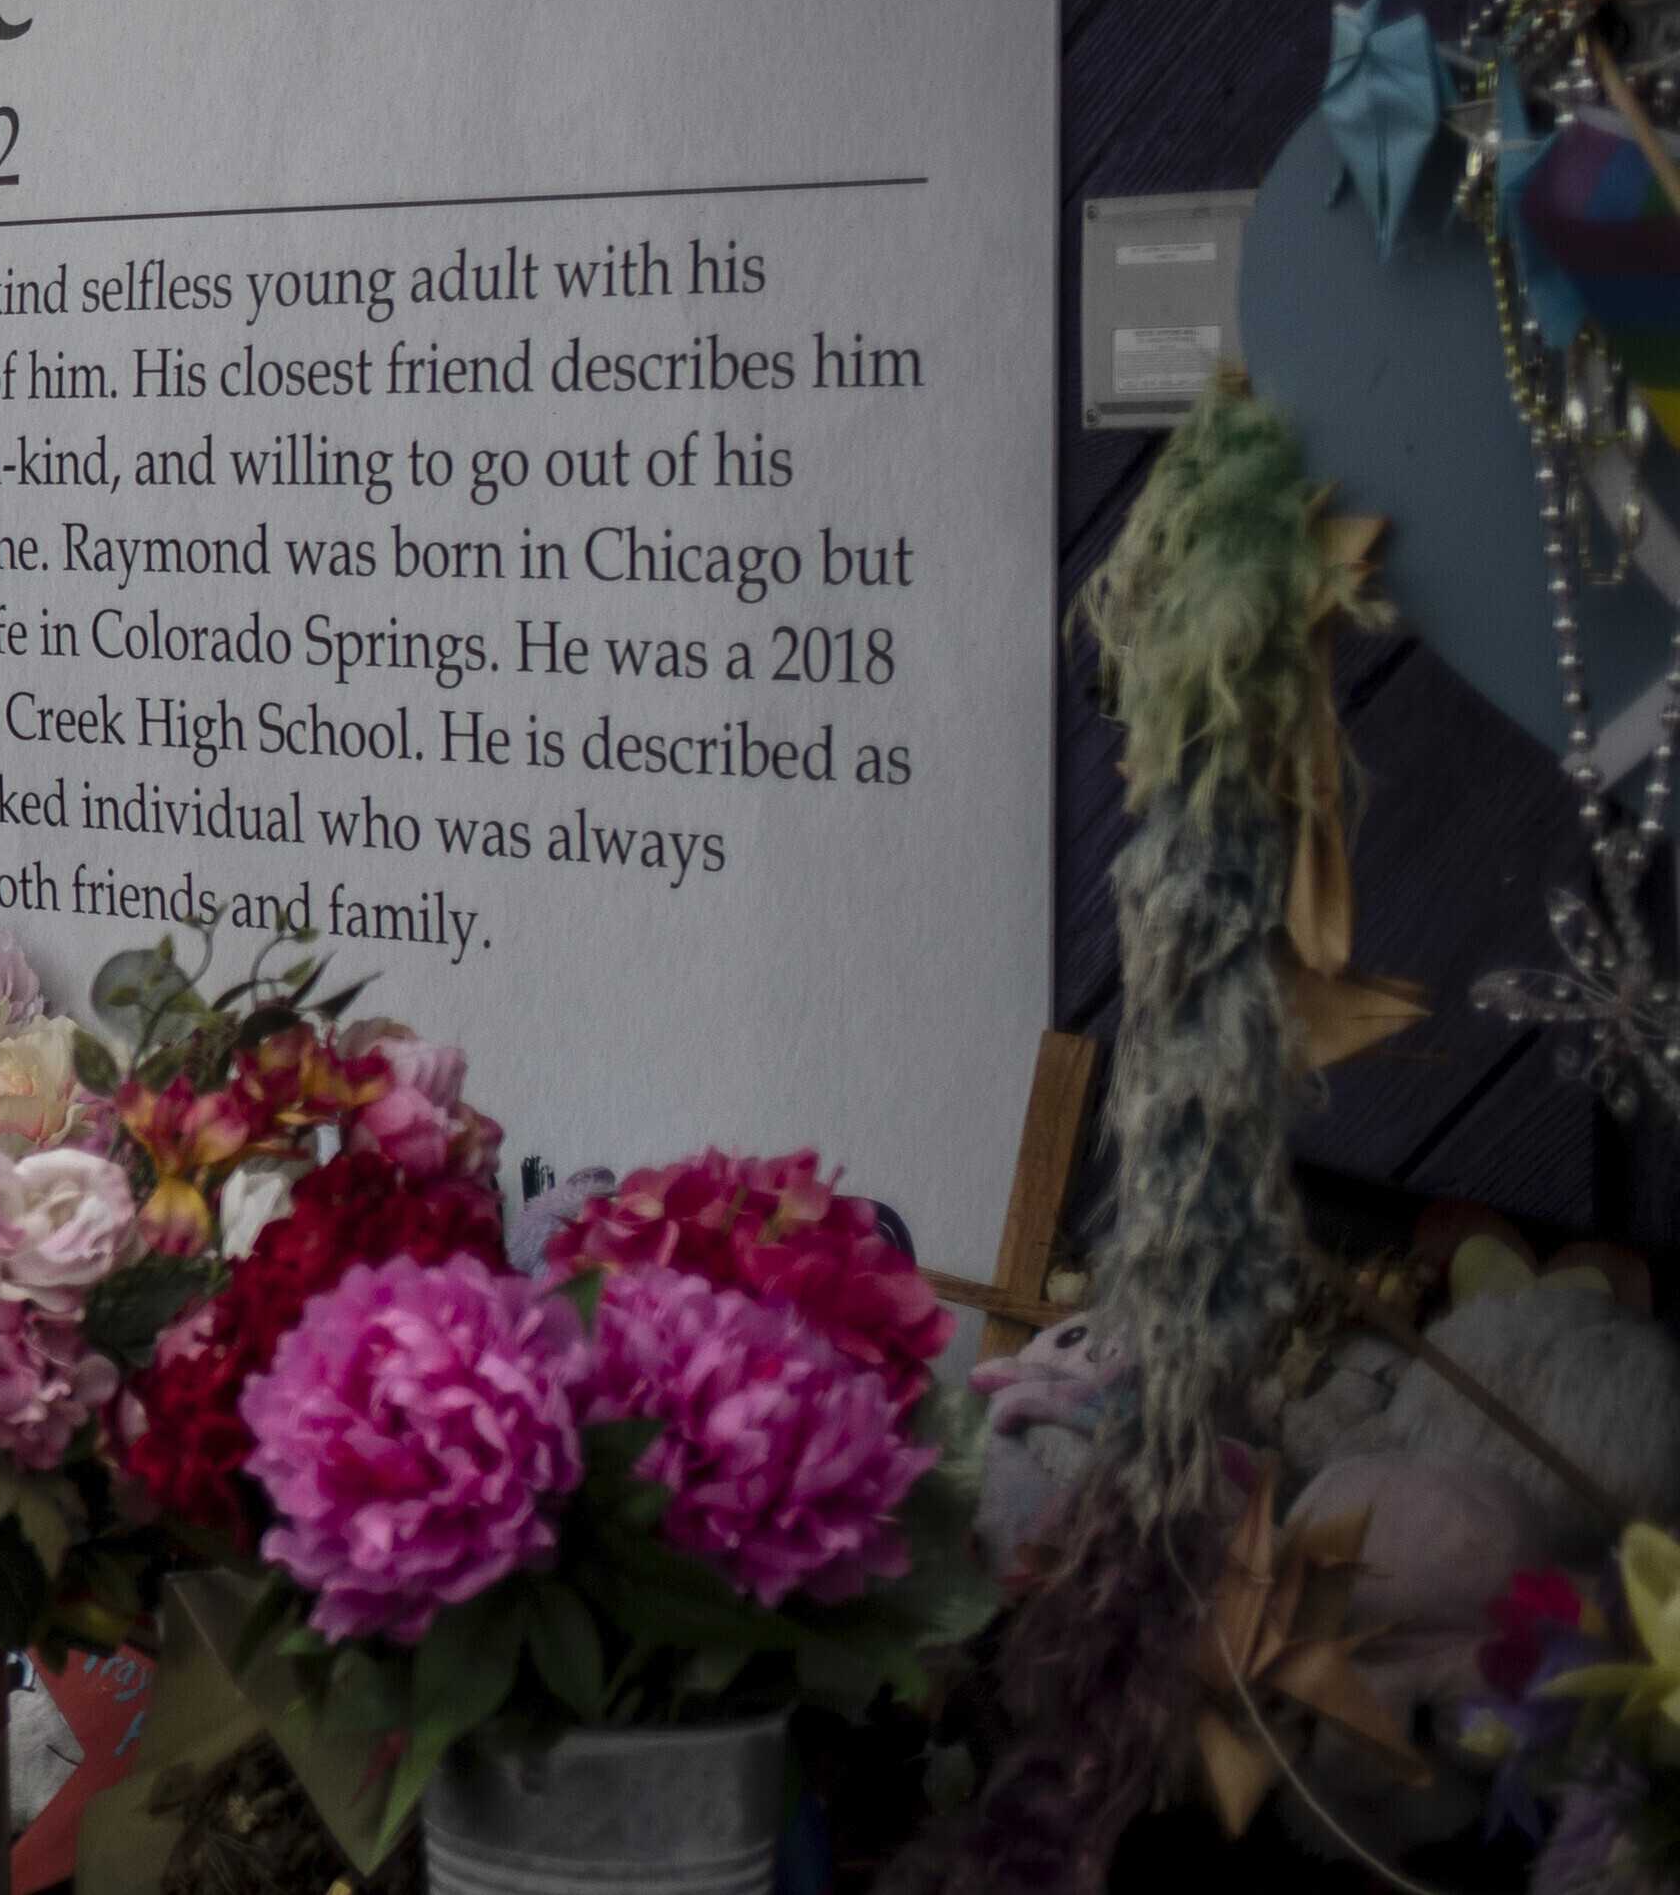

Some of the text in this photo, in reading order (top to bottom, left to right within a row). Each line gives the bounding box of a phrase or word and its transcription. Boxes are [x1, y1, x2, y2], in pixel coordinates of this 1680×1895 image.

[82, 259, 232, 313] selfless
[246, 268, 396, 326] young
[410, 245, 539, 303] adult
[554, 240, 672, 298] with
[688, 238, 766, 294] his
[28, 349, 117, 399] him.
[133, 348, 206, 398] His
[220, 344, 373, 397] closest
[387, 337, 533, 394] friend
[551, 333, 795, 393] describes
[813, 331, 924, 388] him
[135, 433, 216, 486] and
[230, 432, 394, 505] willing
[545, 439, 630, 487] out
[715, 430, 793, 487] his
[62, 522, 271, 590] Raymond
[285, 540, 376, 577] was
[391, 523, 505, 578] born
[584, 525, 802, 604] Chicago
[819, 526, 914, 587] but
[92, 608, 292, 665] Colorado
[305, 614, 498, 689] Springs.
[516, 620, 589, 675] He
[604, 639, 708, 679] was
[771, 625, 895, 685] 2018
[6, 691, 126, 745] Creek
[136, 697, 247, 768] High
[258, 701, 423, 761] School.
[440, 710, 510, 765] He
[582, 714, 836, 781] described
[81, 781, 305, 843] individual
[318, 795, 421, 851] who
[435, 818, 531, 859] was
[548, 807, 725, 889] always
[72, 864, 218, 926] friends
[231, 882, 312, 934] and
[327, 883, 491, 966] family.
